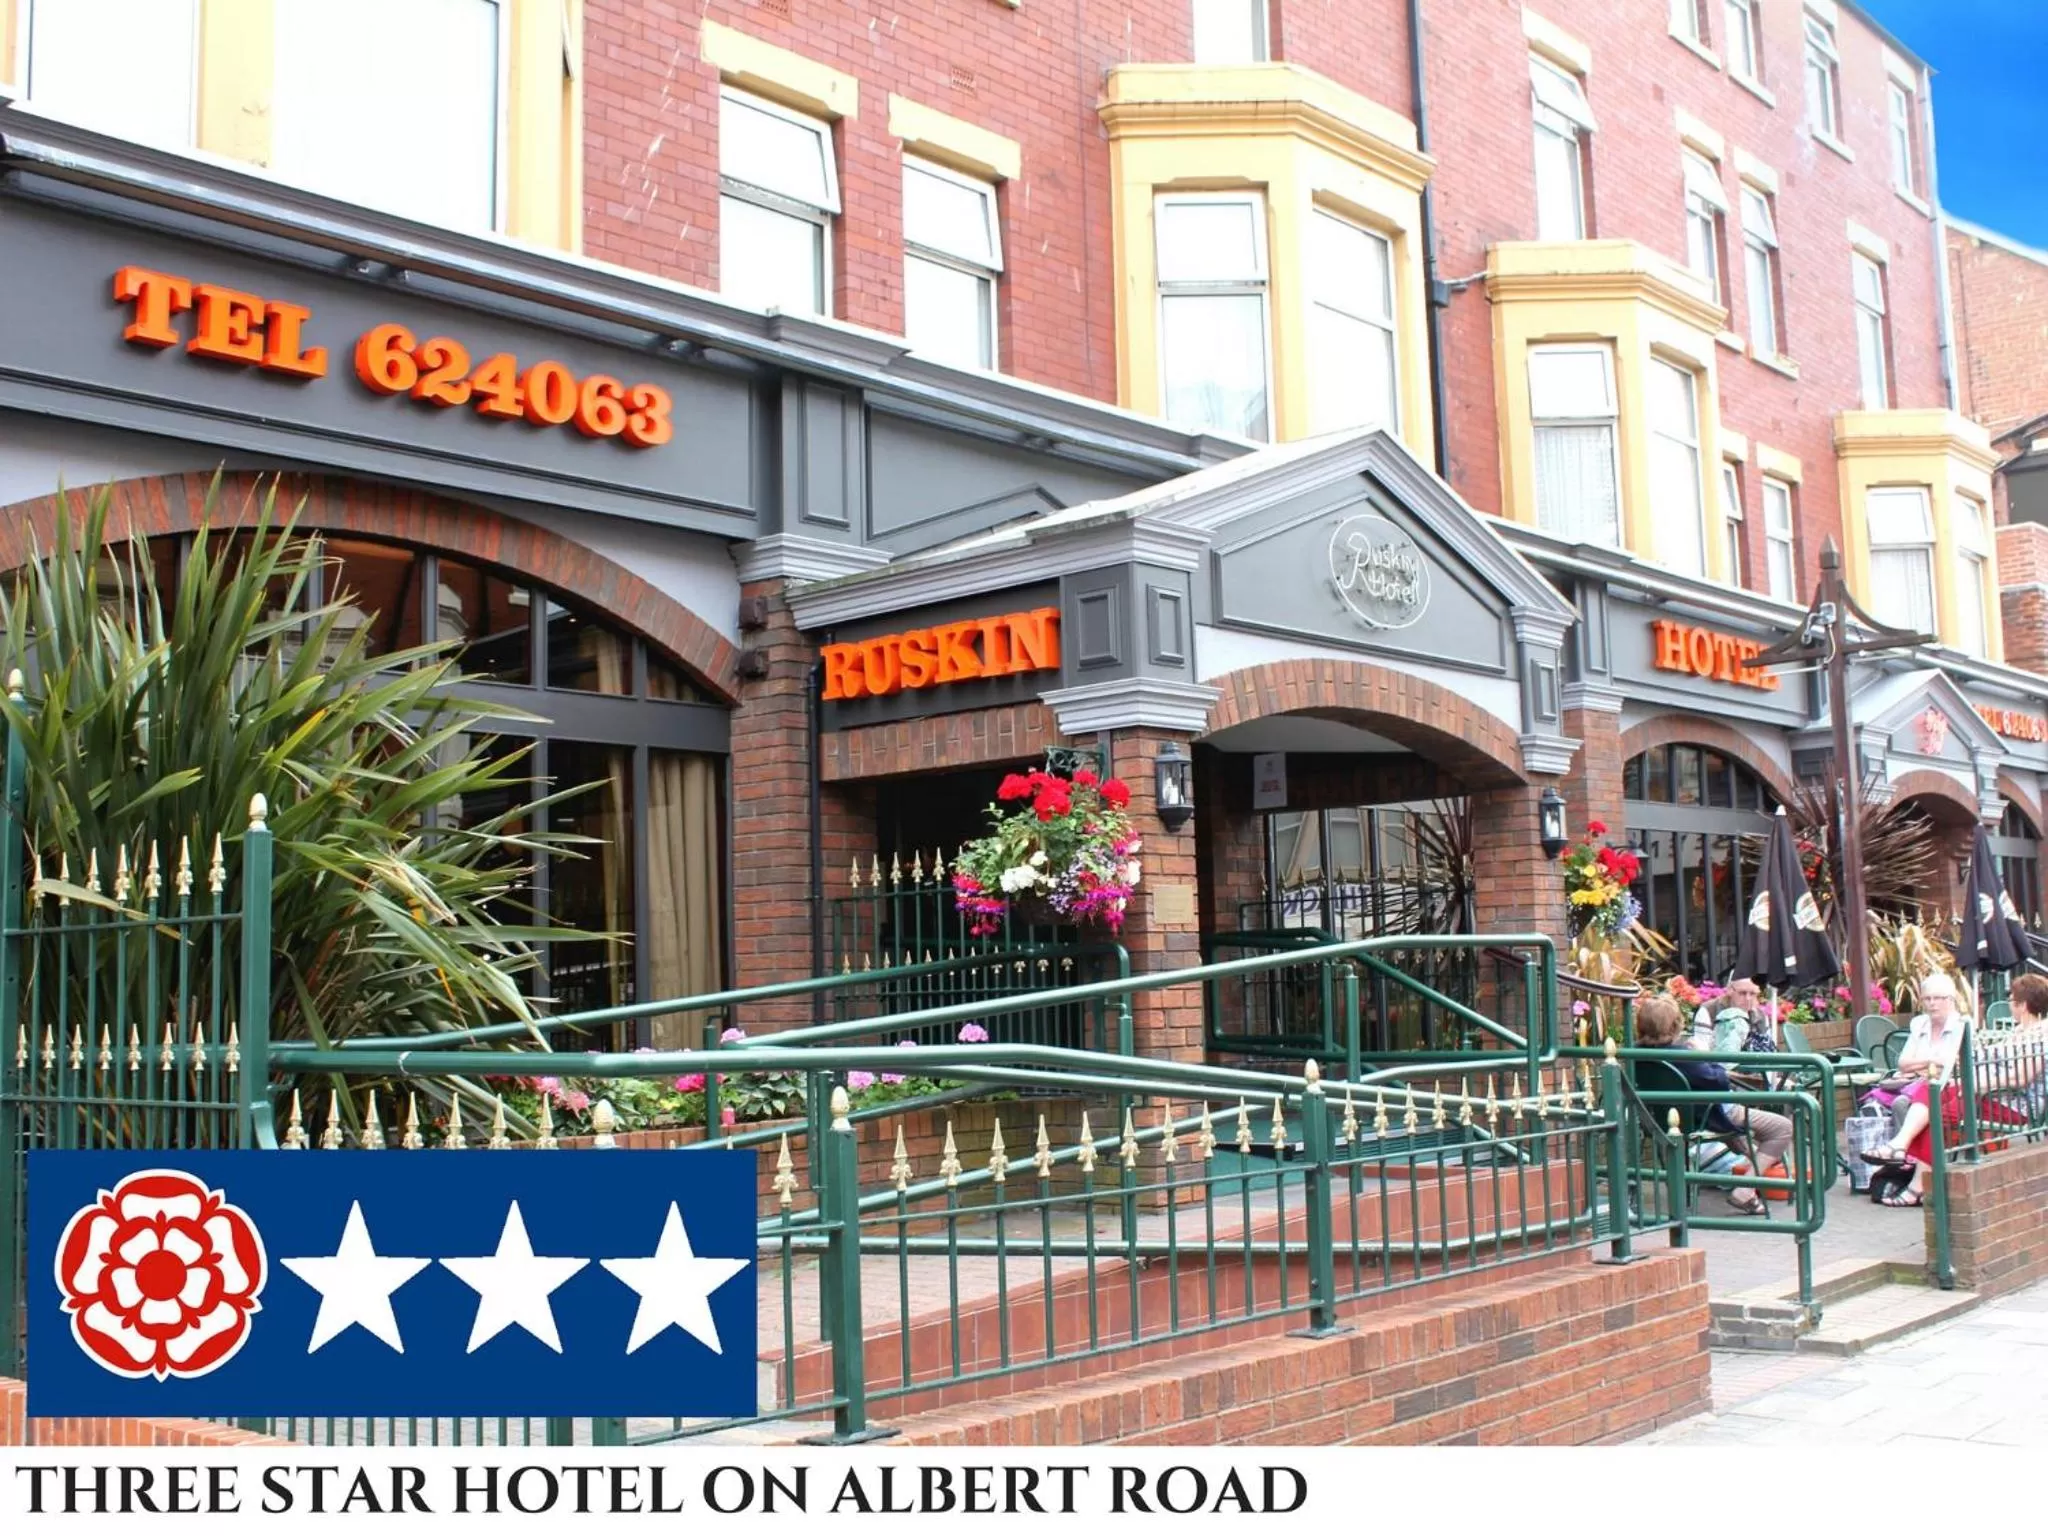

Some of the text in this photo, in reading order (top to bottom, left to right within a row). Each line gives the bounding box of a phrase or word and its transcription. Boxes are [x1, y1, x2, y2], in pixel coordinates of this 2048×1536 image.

[113, 266, 673, 448] TEL 624063
[820, 607, 1061, 701] RUSKIN
[1651, 619, 1782, 690] HOTEL
